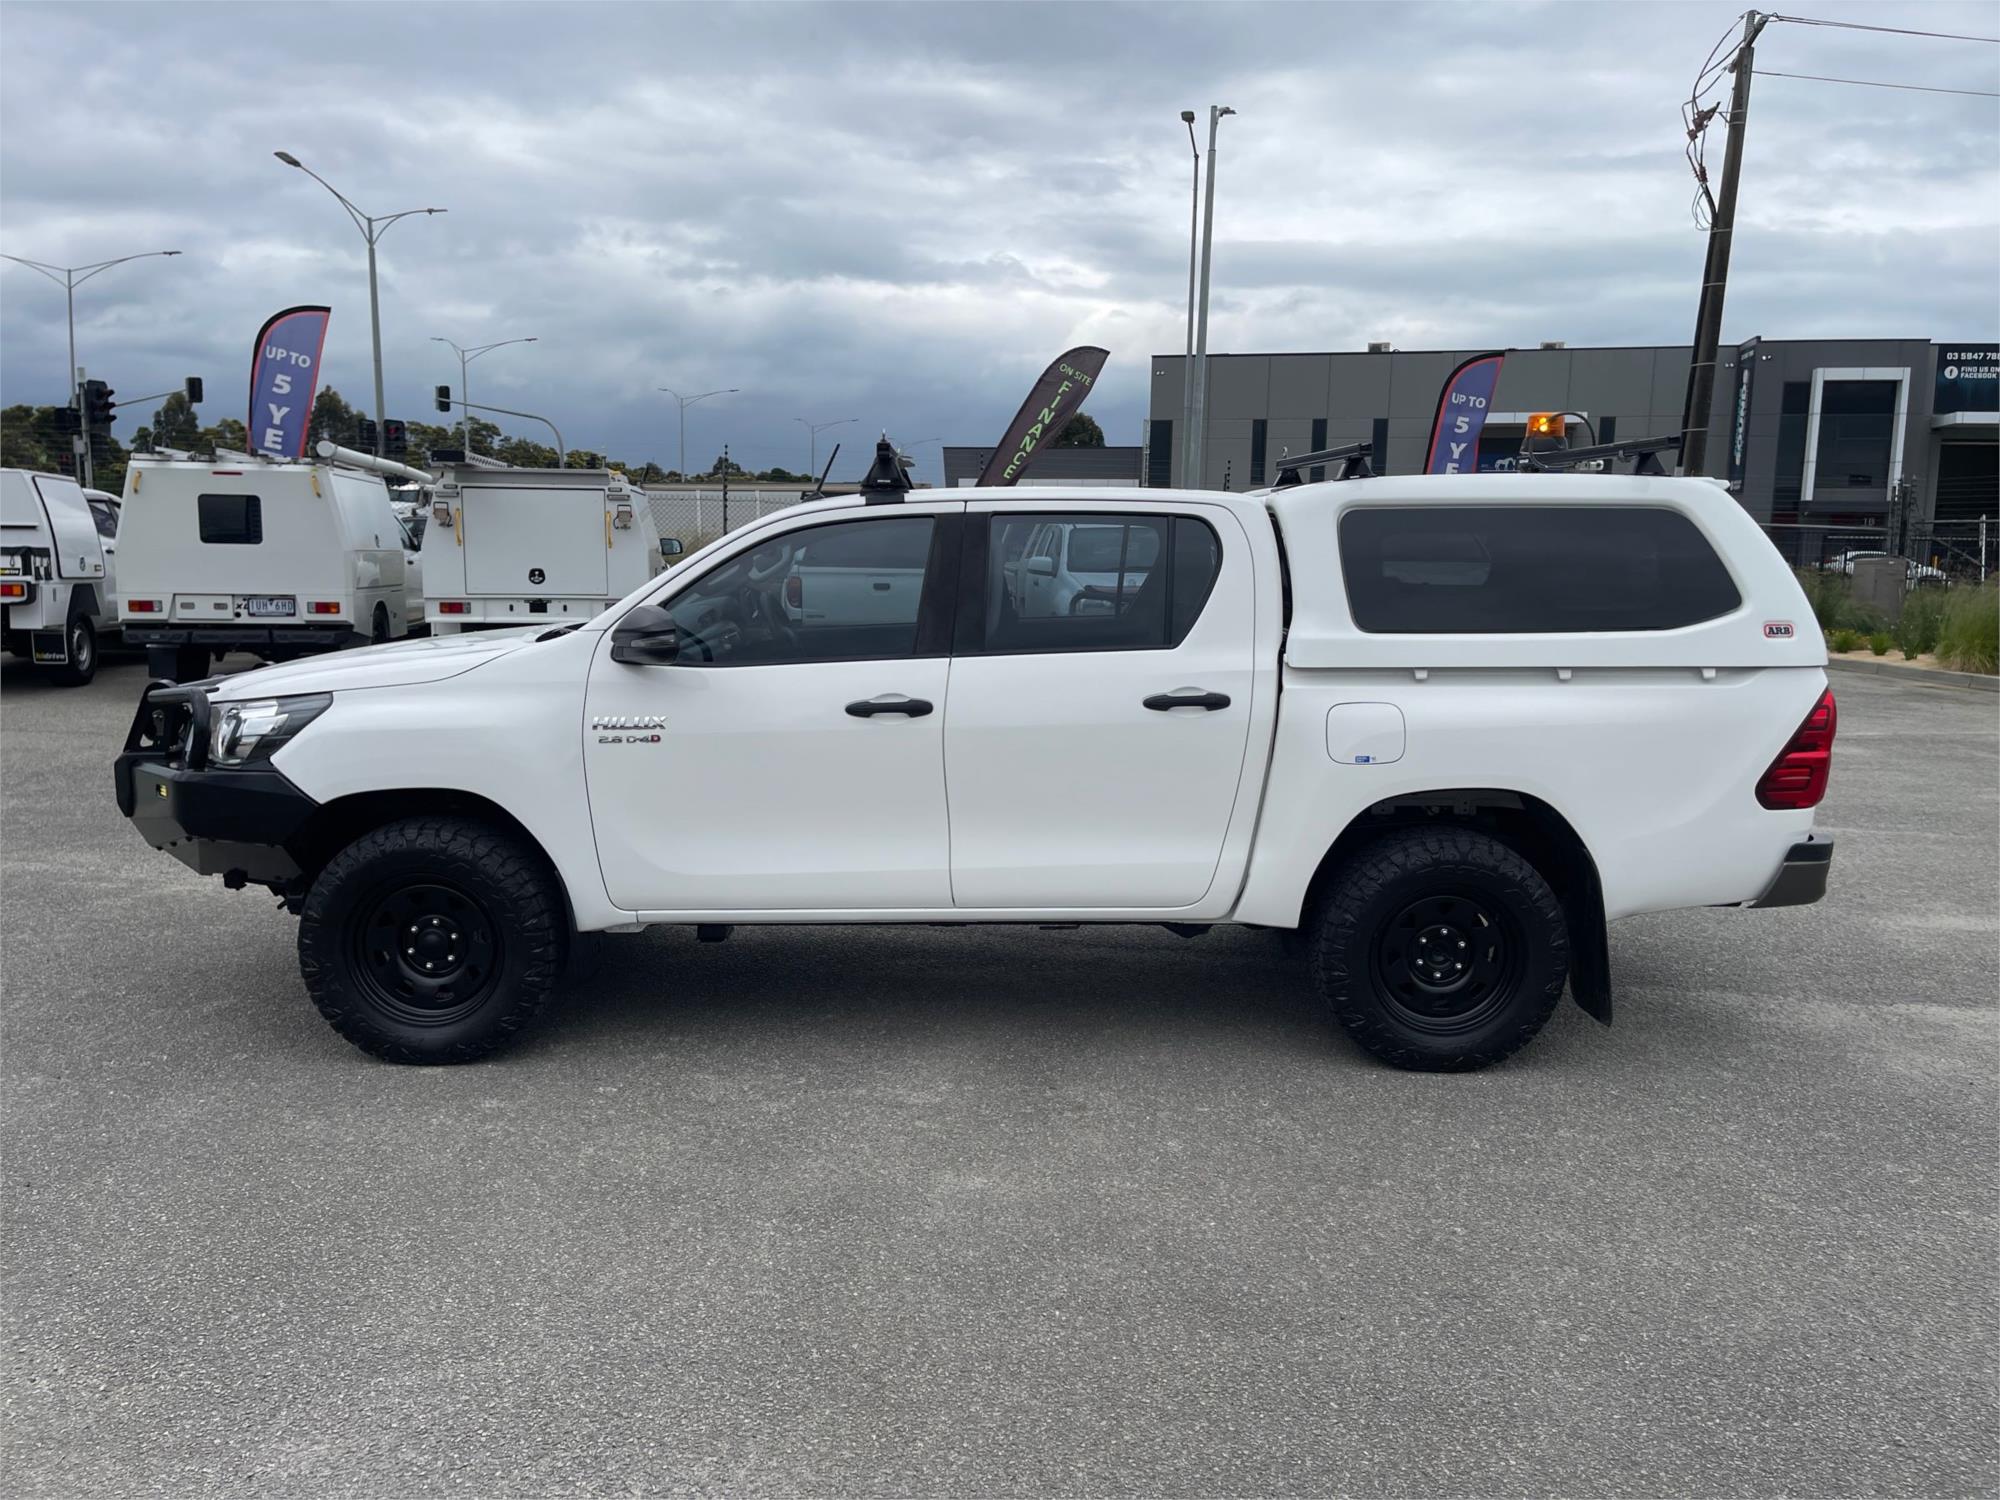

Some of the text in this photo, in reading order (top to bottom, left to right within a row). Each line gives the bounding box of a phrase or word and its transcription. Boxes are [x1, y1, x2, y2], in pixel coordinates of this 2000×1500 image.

[265, 345, 311, 368] UP TO
[1946, 352, 1959, 360] 03
[272, 373, 292, 394] 5
[1059, 363, 1092, 386] ON SITE
[1451, 392, 1486, 409] UP TO
[1003, 381, 1072, 479] FINANCE
[1454, 416, 1469, 434] 5
[1768, 626, 1791, 635] ARB
[592, 716, 666, 731] HILUX
